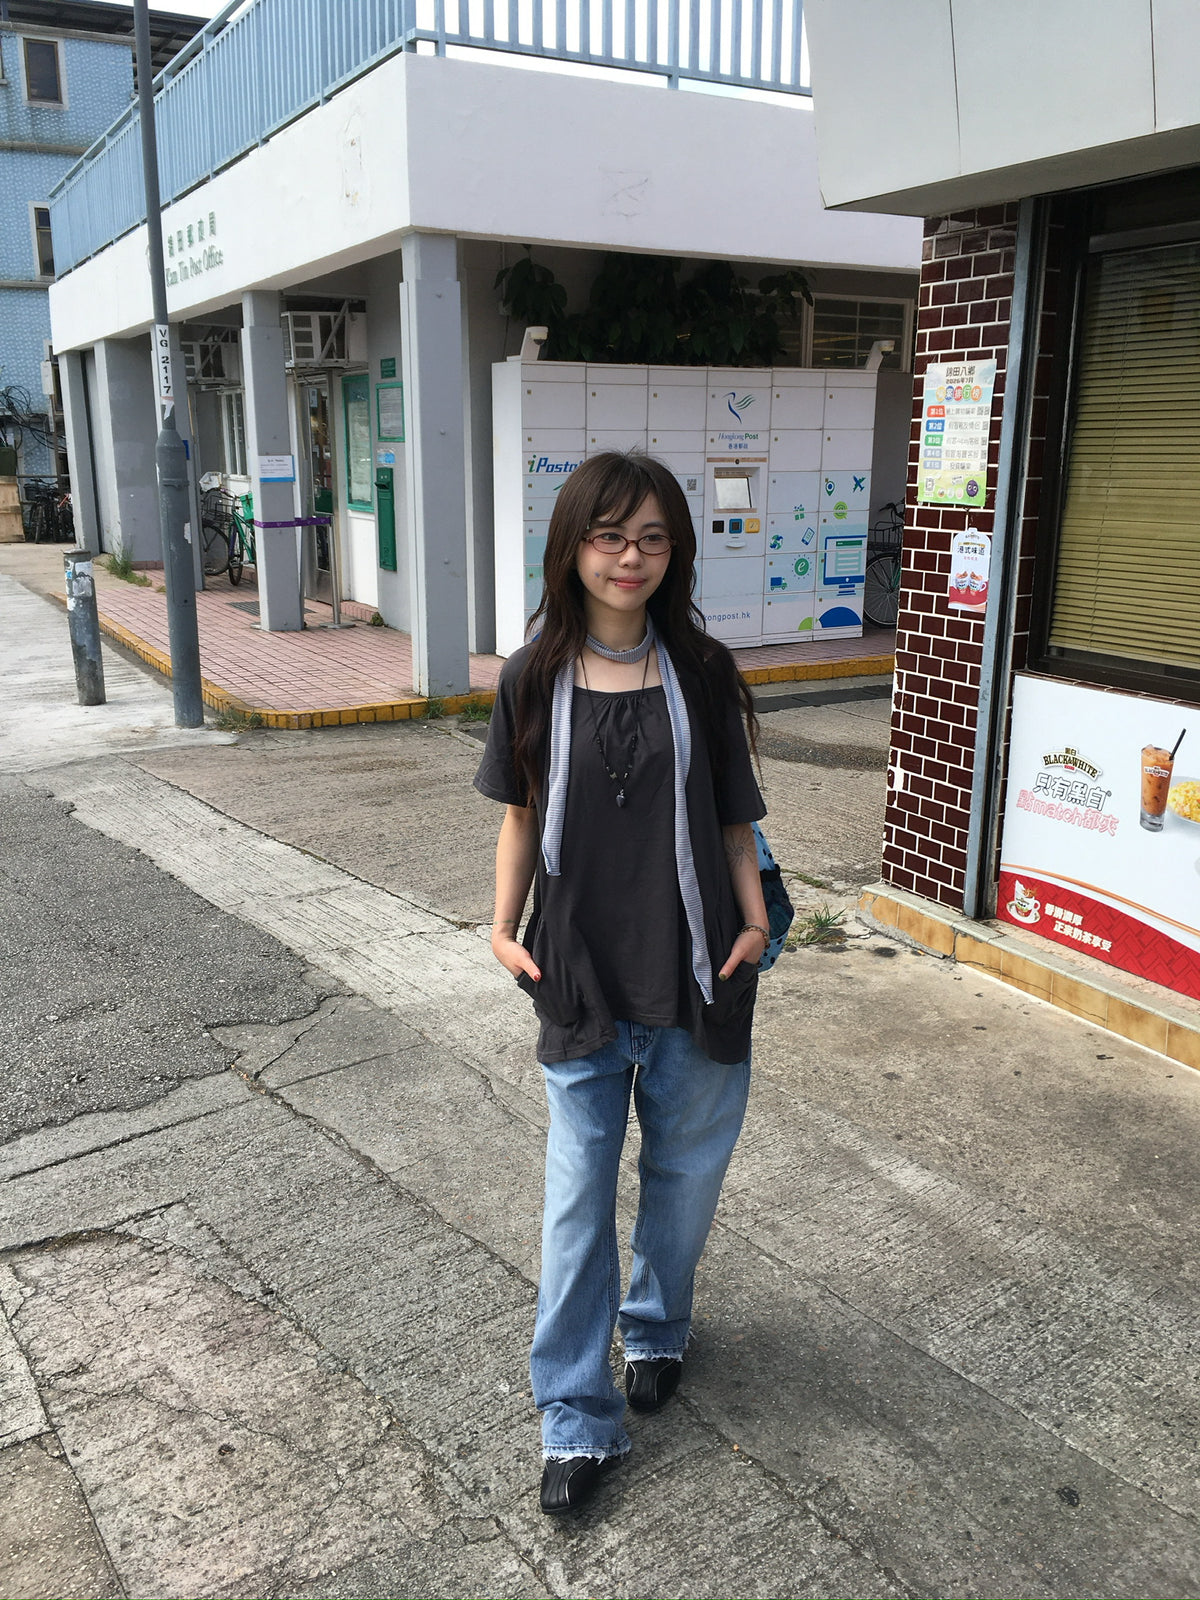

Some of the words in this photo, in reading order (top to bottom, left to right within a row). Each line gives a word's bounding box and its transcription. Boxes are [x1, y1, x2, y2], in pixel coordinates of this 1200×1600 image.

[189, 257, 203, 278] Post
[203, 245, 224, 271] Office
[159, 329, 168, 347] VG
[161, 356, 171, 394] 2117
[1053, 920, 1113, 953] 正宗奶茶享受
